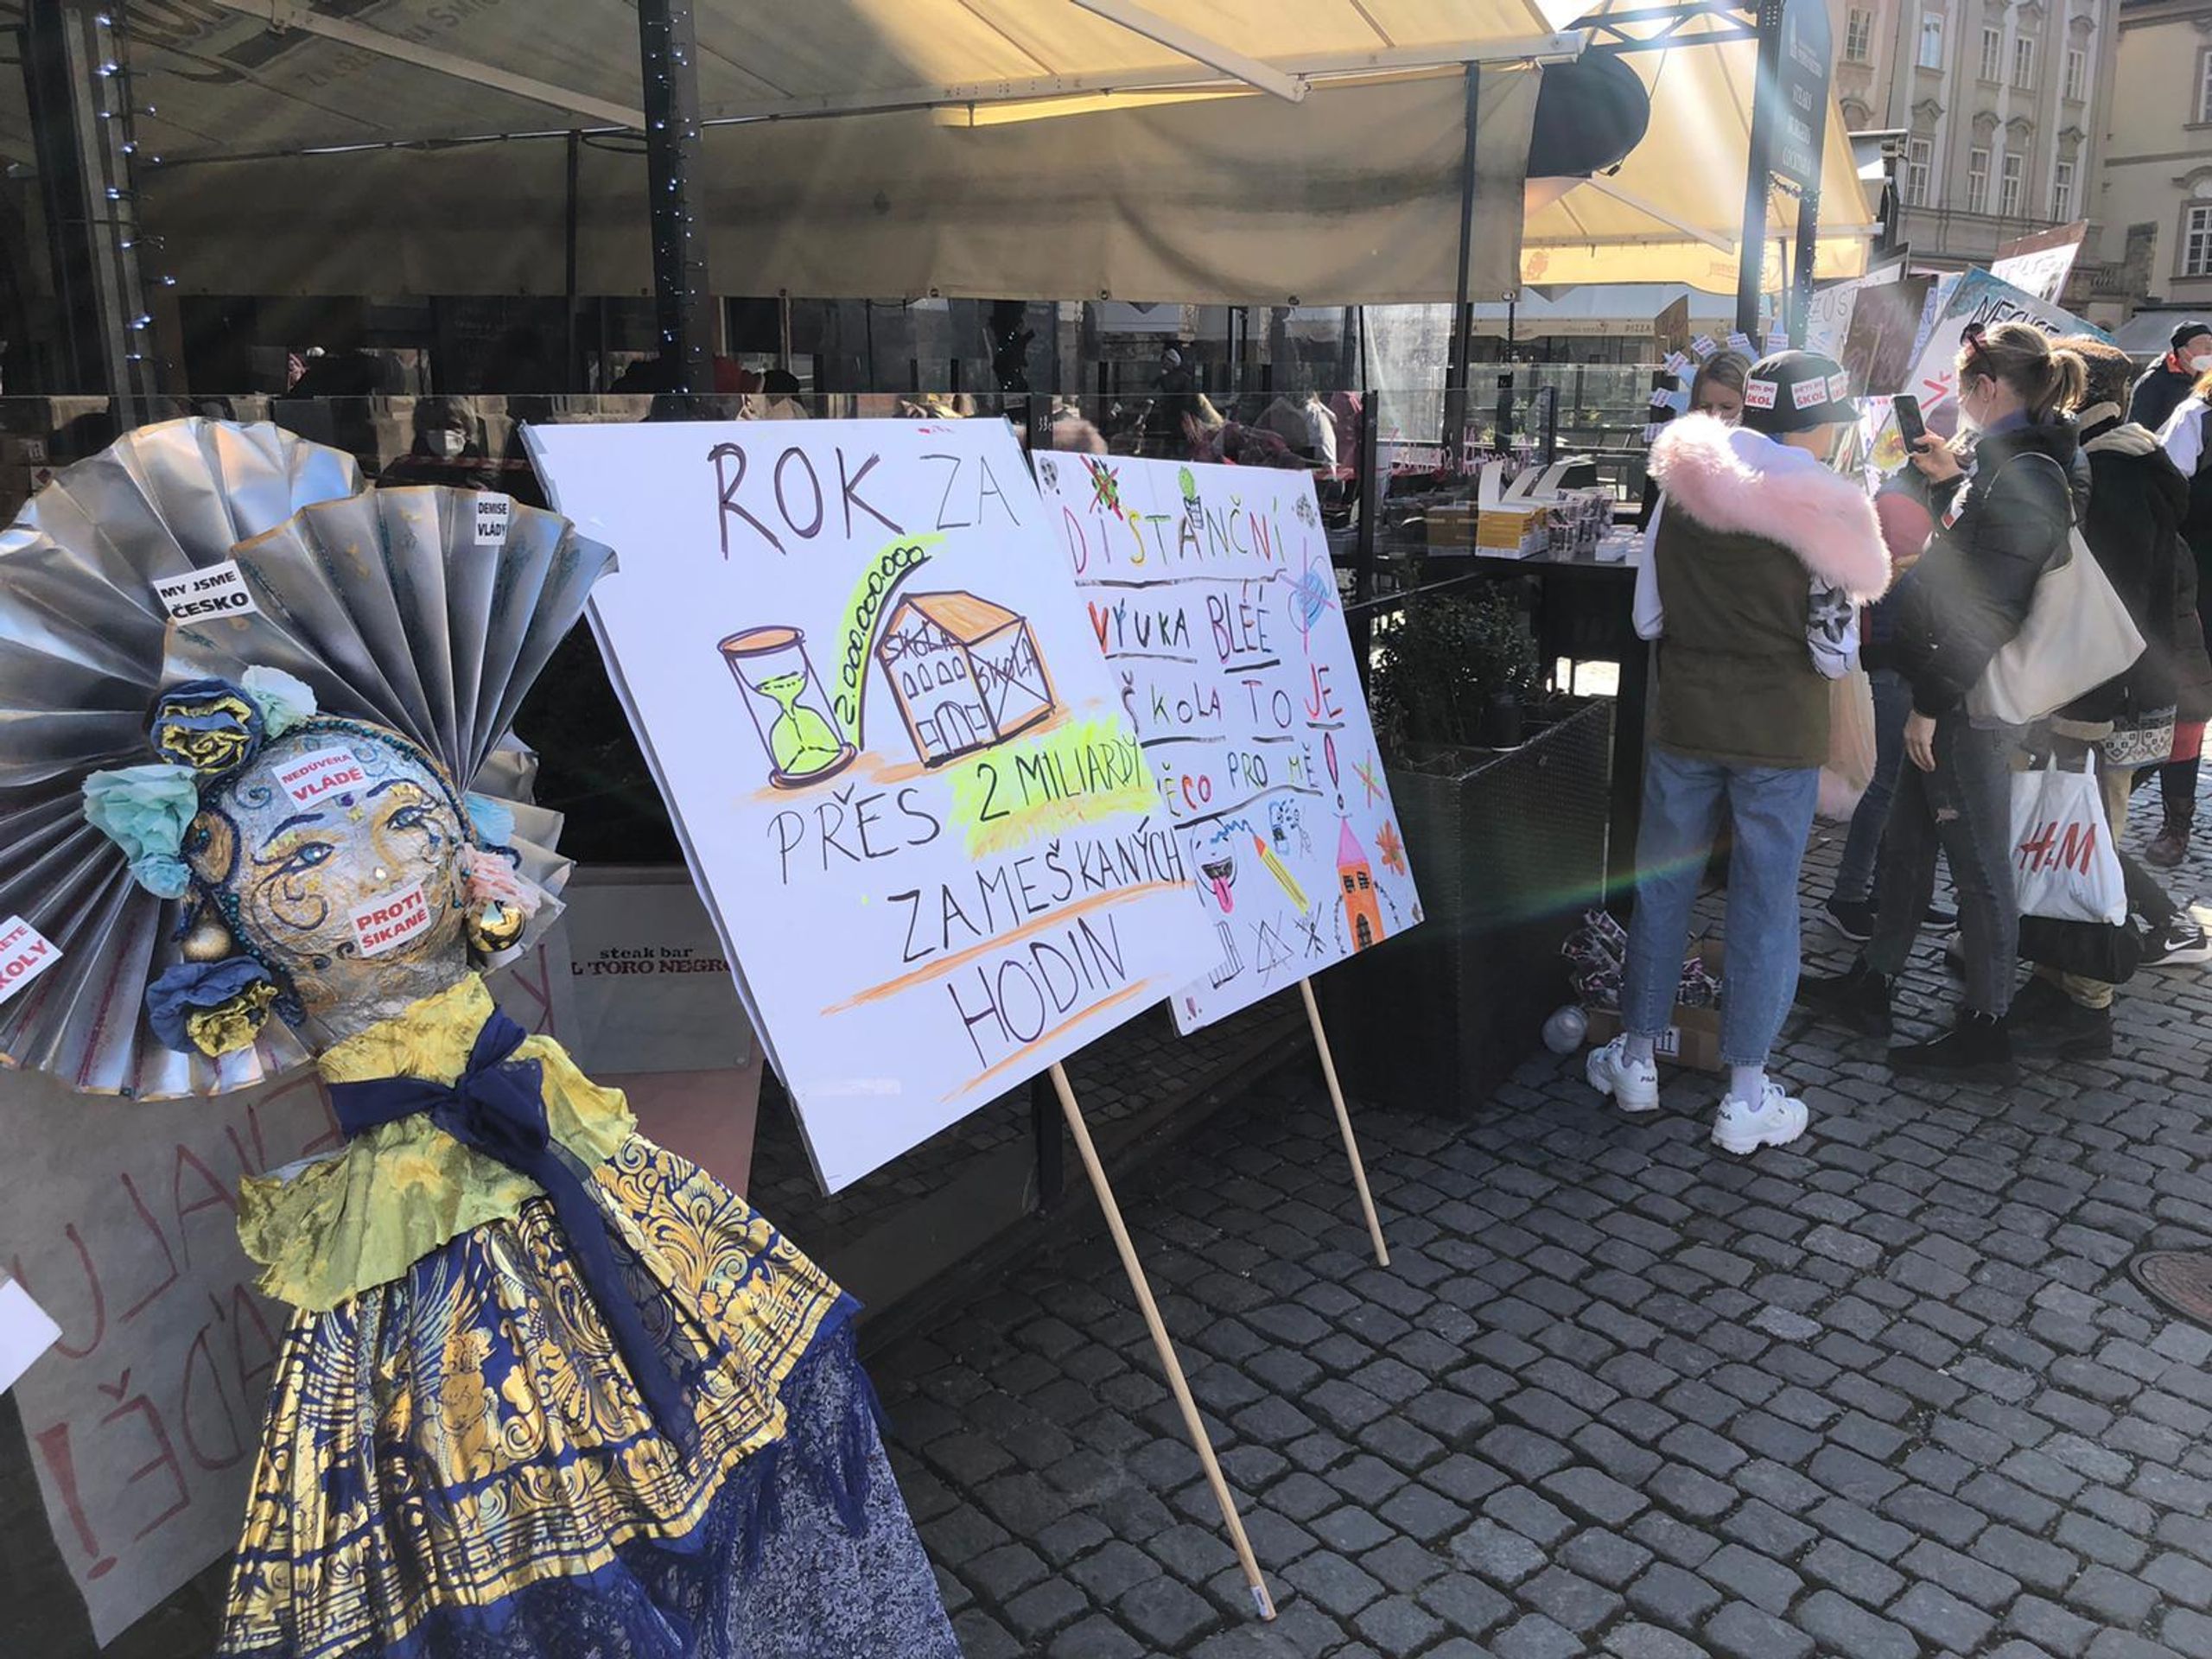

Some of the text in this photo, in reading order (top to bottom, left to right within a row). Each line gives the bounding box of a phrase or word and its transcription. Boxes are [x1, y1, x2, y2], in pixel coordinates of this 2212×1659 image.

[478, 501, 507, 516] DEMISE
[709, 442, 1021, 559] ROK ZA
[478, 522, 507, 537] VLÁDY
[161, 570, 237, 600] MY JSME
[172, 592, 249, 620] ČESKO
[1122, 663, 1344, 735] ŠKOLA TO JE
[768, 734, 1141, 884] PŘES 2 MILIARDY
[1156, 761, 1212, 817] ĚCO
[1228, 752, 1268, 788] PRO
[2017, 821, 2097, 876] H&M
[356, 891, 423, 931] PROTI
[888, 816, 1186, 963] ZAMEŠKANÝCH
[600, 947, 695, 959] steak bar
[947, 912, 1126, 1068] HODIN
